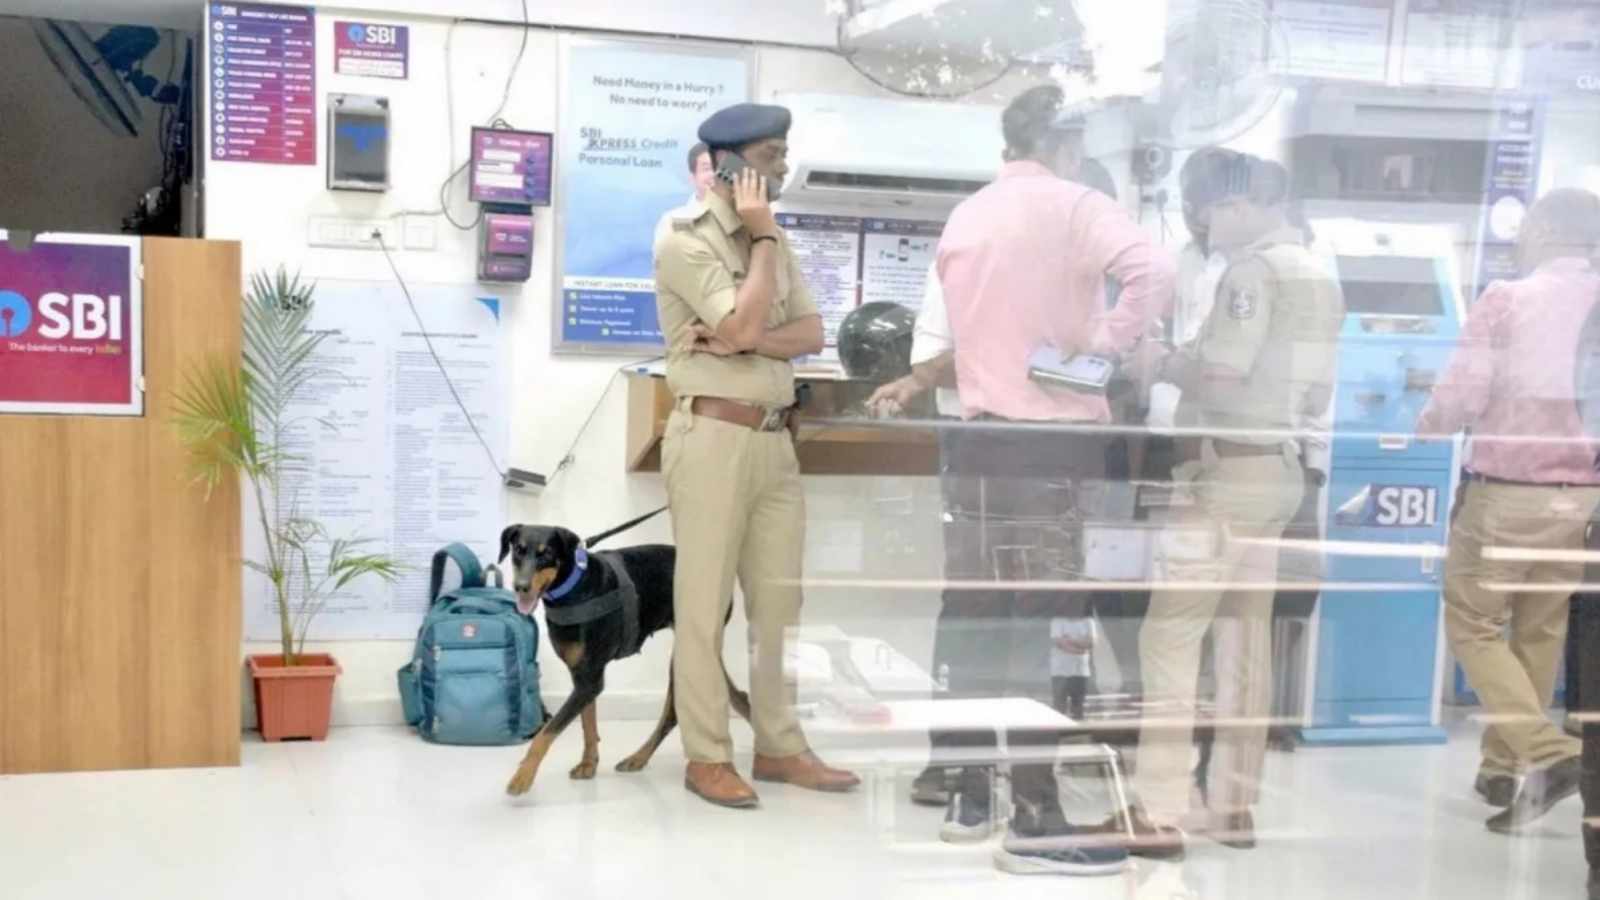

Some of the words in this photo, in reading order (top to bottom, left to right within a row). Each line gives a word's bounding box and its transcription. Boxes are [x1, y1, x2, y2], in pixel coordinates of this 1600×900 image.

[366, 26, 396, 44] SBI
[593, 75, 622, 88] Need
[624, 77, 661, 93] Money
[663, 82, 673, 91] in
[684, 82, 715, 95] Hurry
[610, 93, 625, 104] No
[628, 95, 655, 107] need
[657, 96, 669, 107] to
[671, 99, 707, 112] worry!
[580, 127, 602, 139] SBI
[641, 138, 678, 150] Credit
[578, 152, 631, 166] Personal
[633, 155, 662, 168] Loan
[38, 291, 122, 340] SBI
[8, 341, 26, 352] The
[58, 343, 69, 352] to
[70, 345, 94, 355] every
[1376, 486, 1437, 525] SBI
